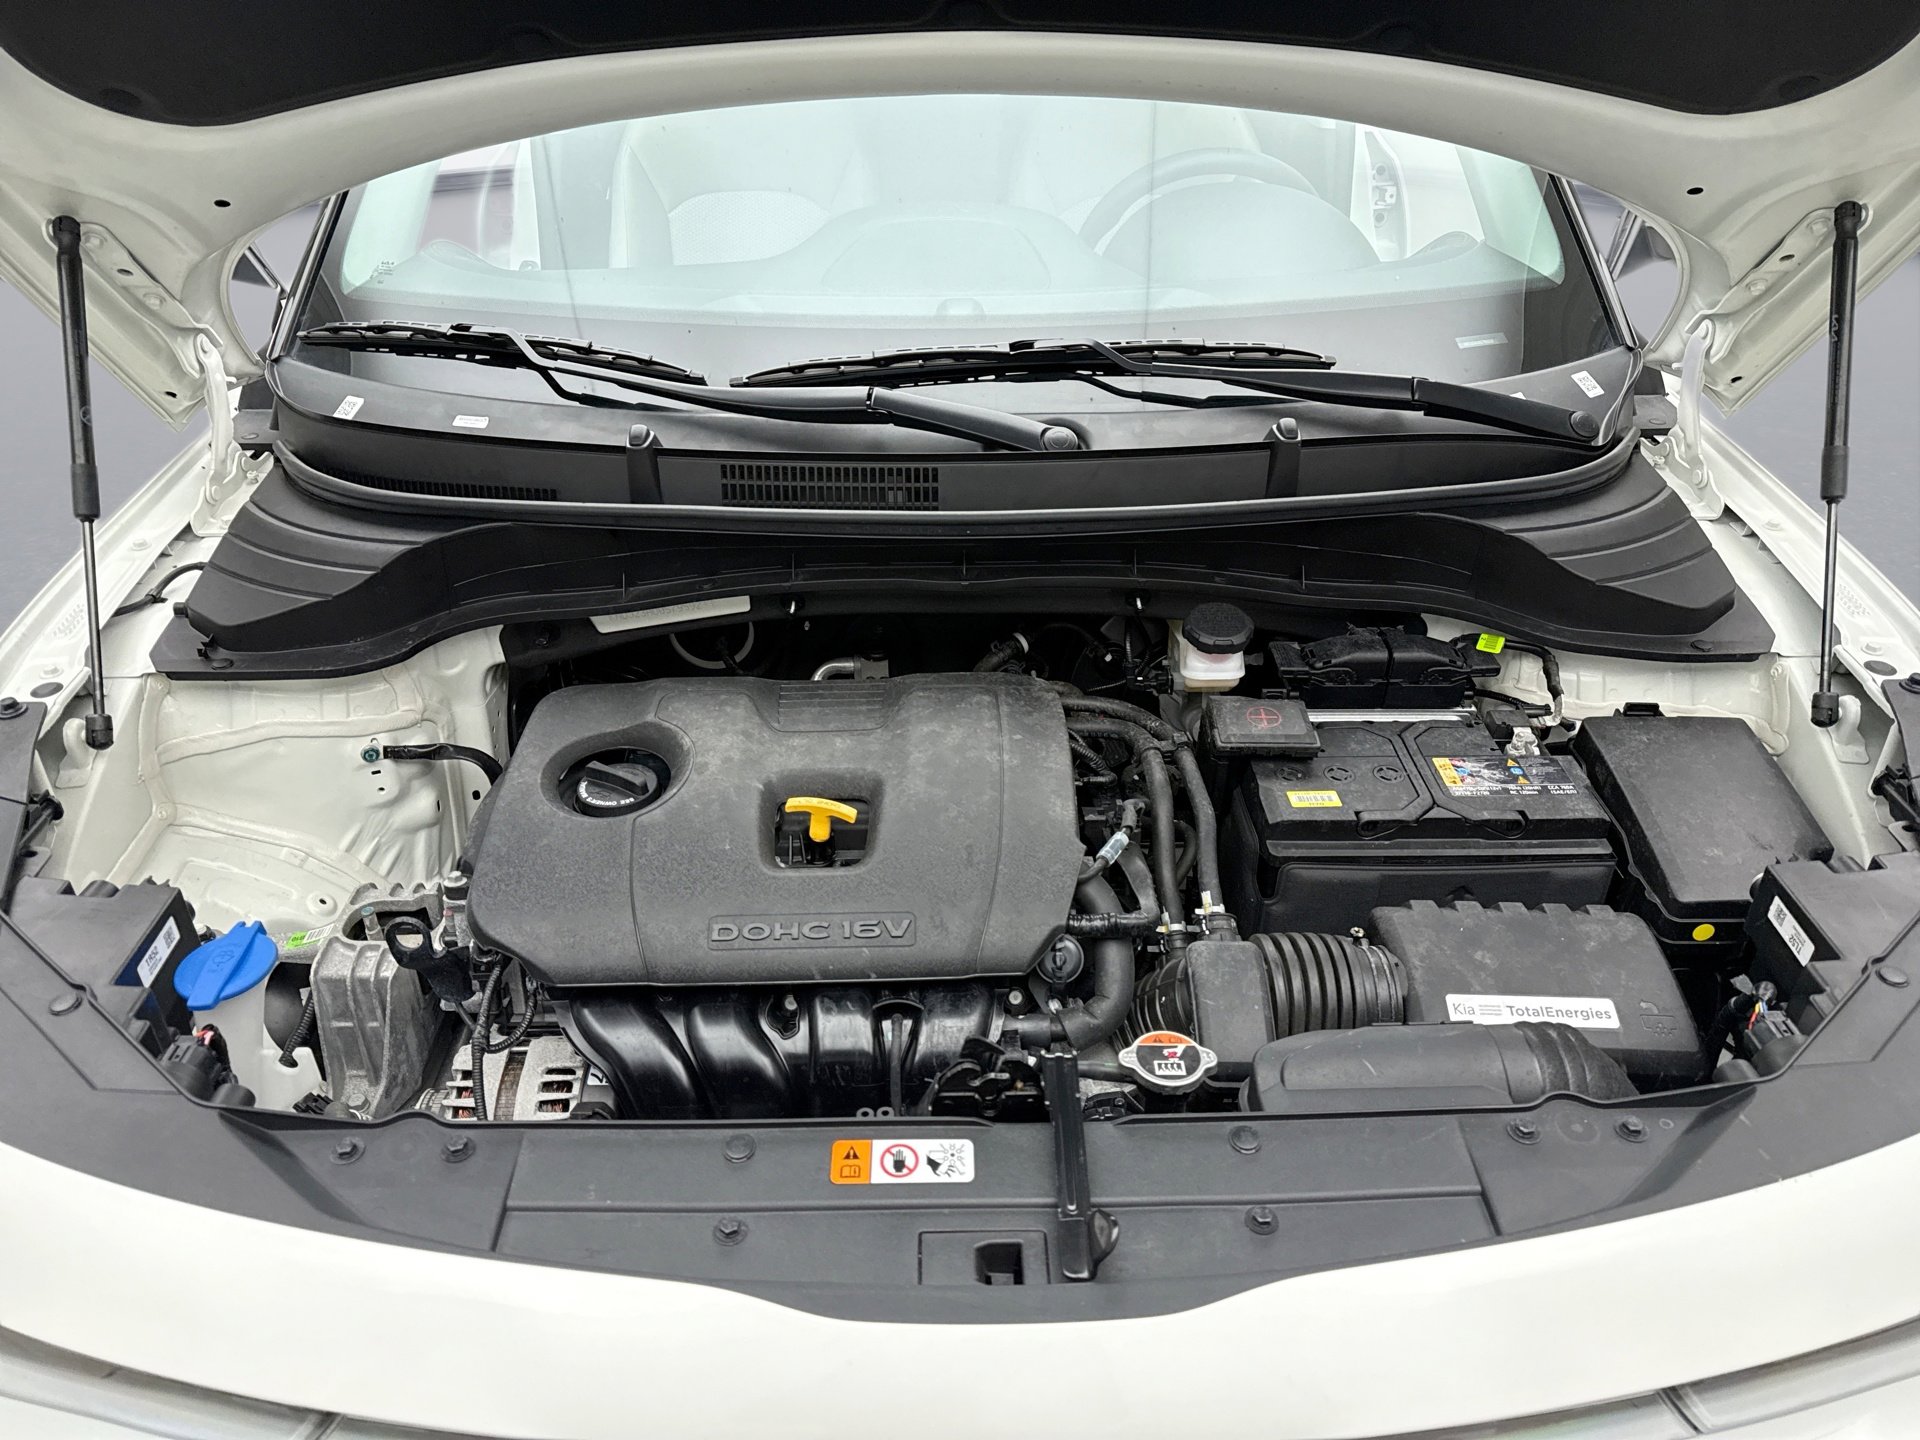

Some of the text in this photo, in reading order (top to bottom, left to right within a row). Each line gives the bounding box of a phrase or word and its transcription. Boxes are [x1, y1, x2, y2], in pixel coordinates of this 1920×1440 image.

[711, 919, 913, 942] DOHC 16V
[1452, 1002, 1612, 1021] Kia TotalEnergies
